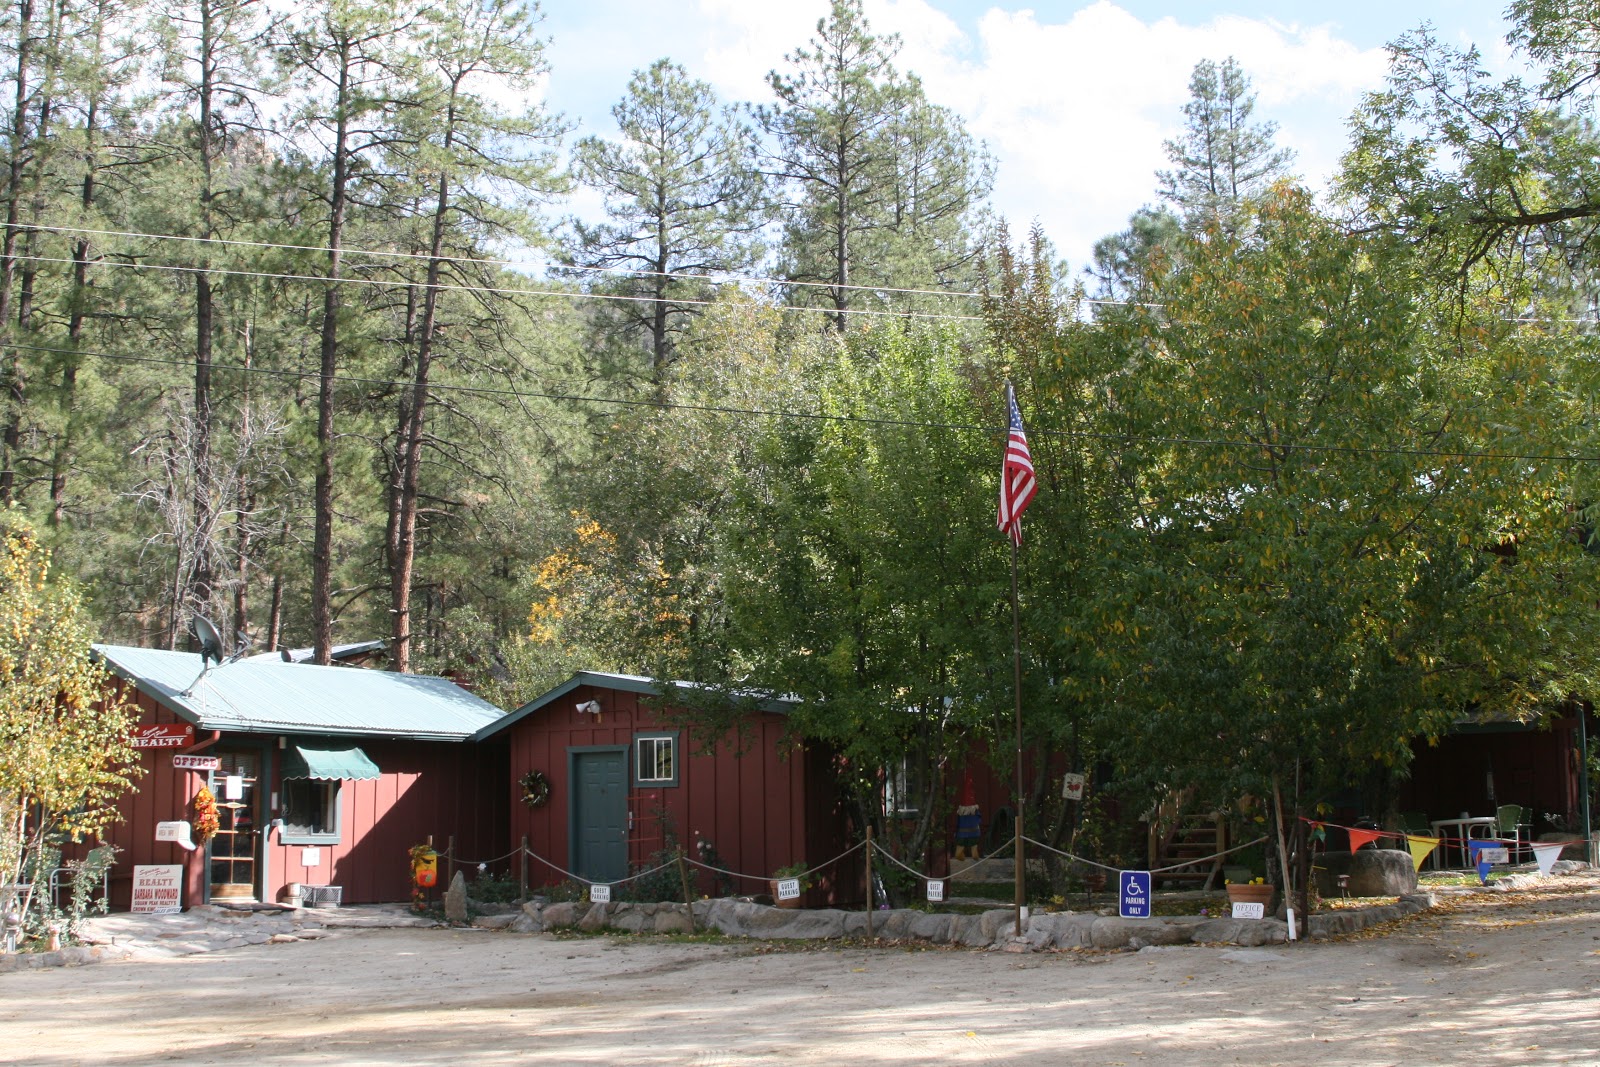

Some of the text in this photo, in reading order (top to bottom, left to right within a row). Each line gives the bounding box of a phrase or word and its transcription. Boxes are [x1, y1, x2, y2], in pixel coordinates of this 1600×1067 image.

[131, 738, 184, 747] REALTY
[174, 757, 217, 767] OFFICE
[781, 882, 796, 890] GUEST
[930, 883, 941, 891] GUEST
[134, 889, 153, 900] BARBARA
[780, 888, 799, 898] PARKING
[928, 890, 942, 898] PARKING
[1125, 897, 1146, 905] PARKING
[1235, 904, 1261, 912] OFFICE
